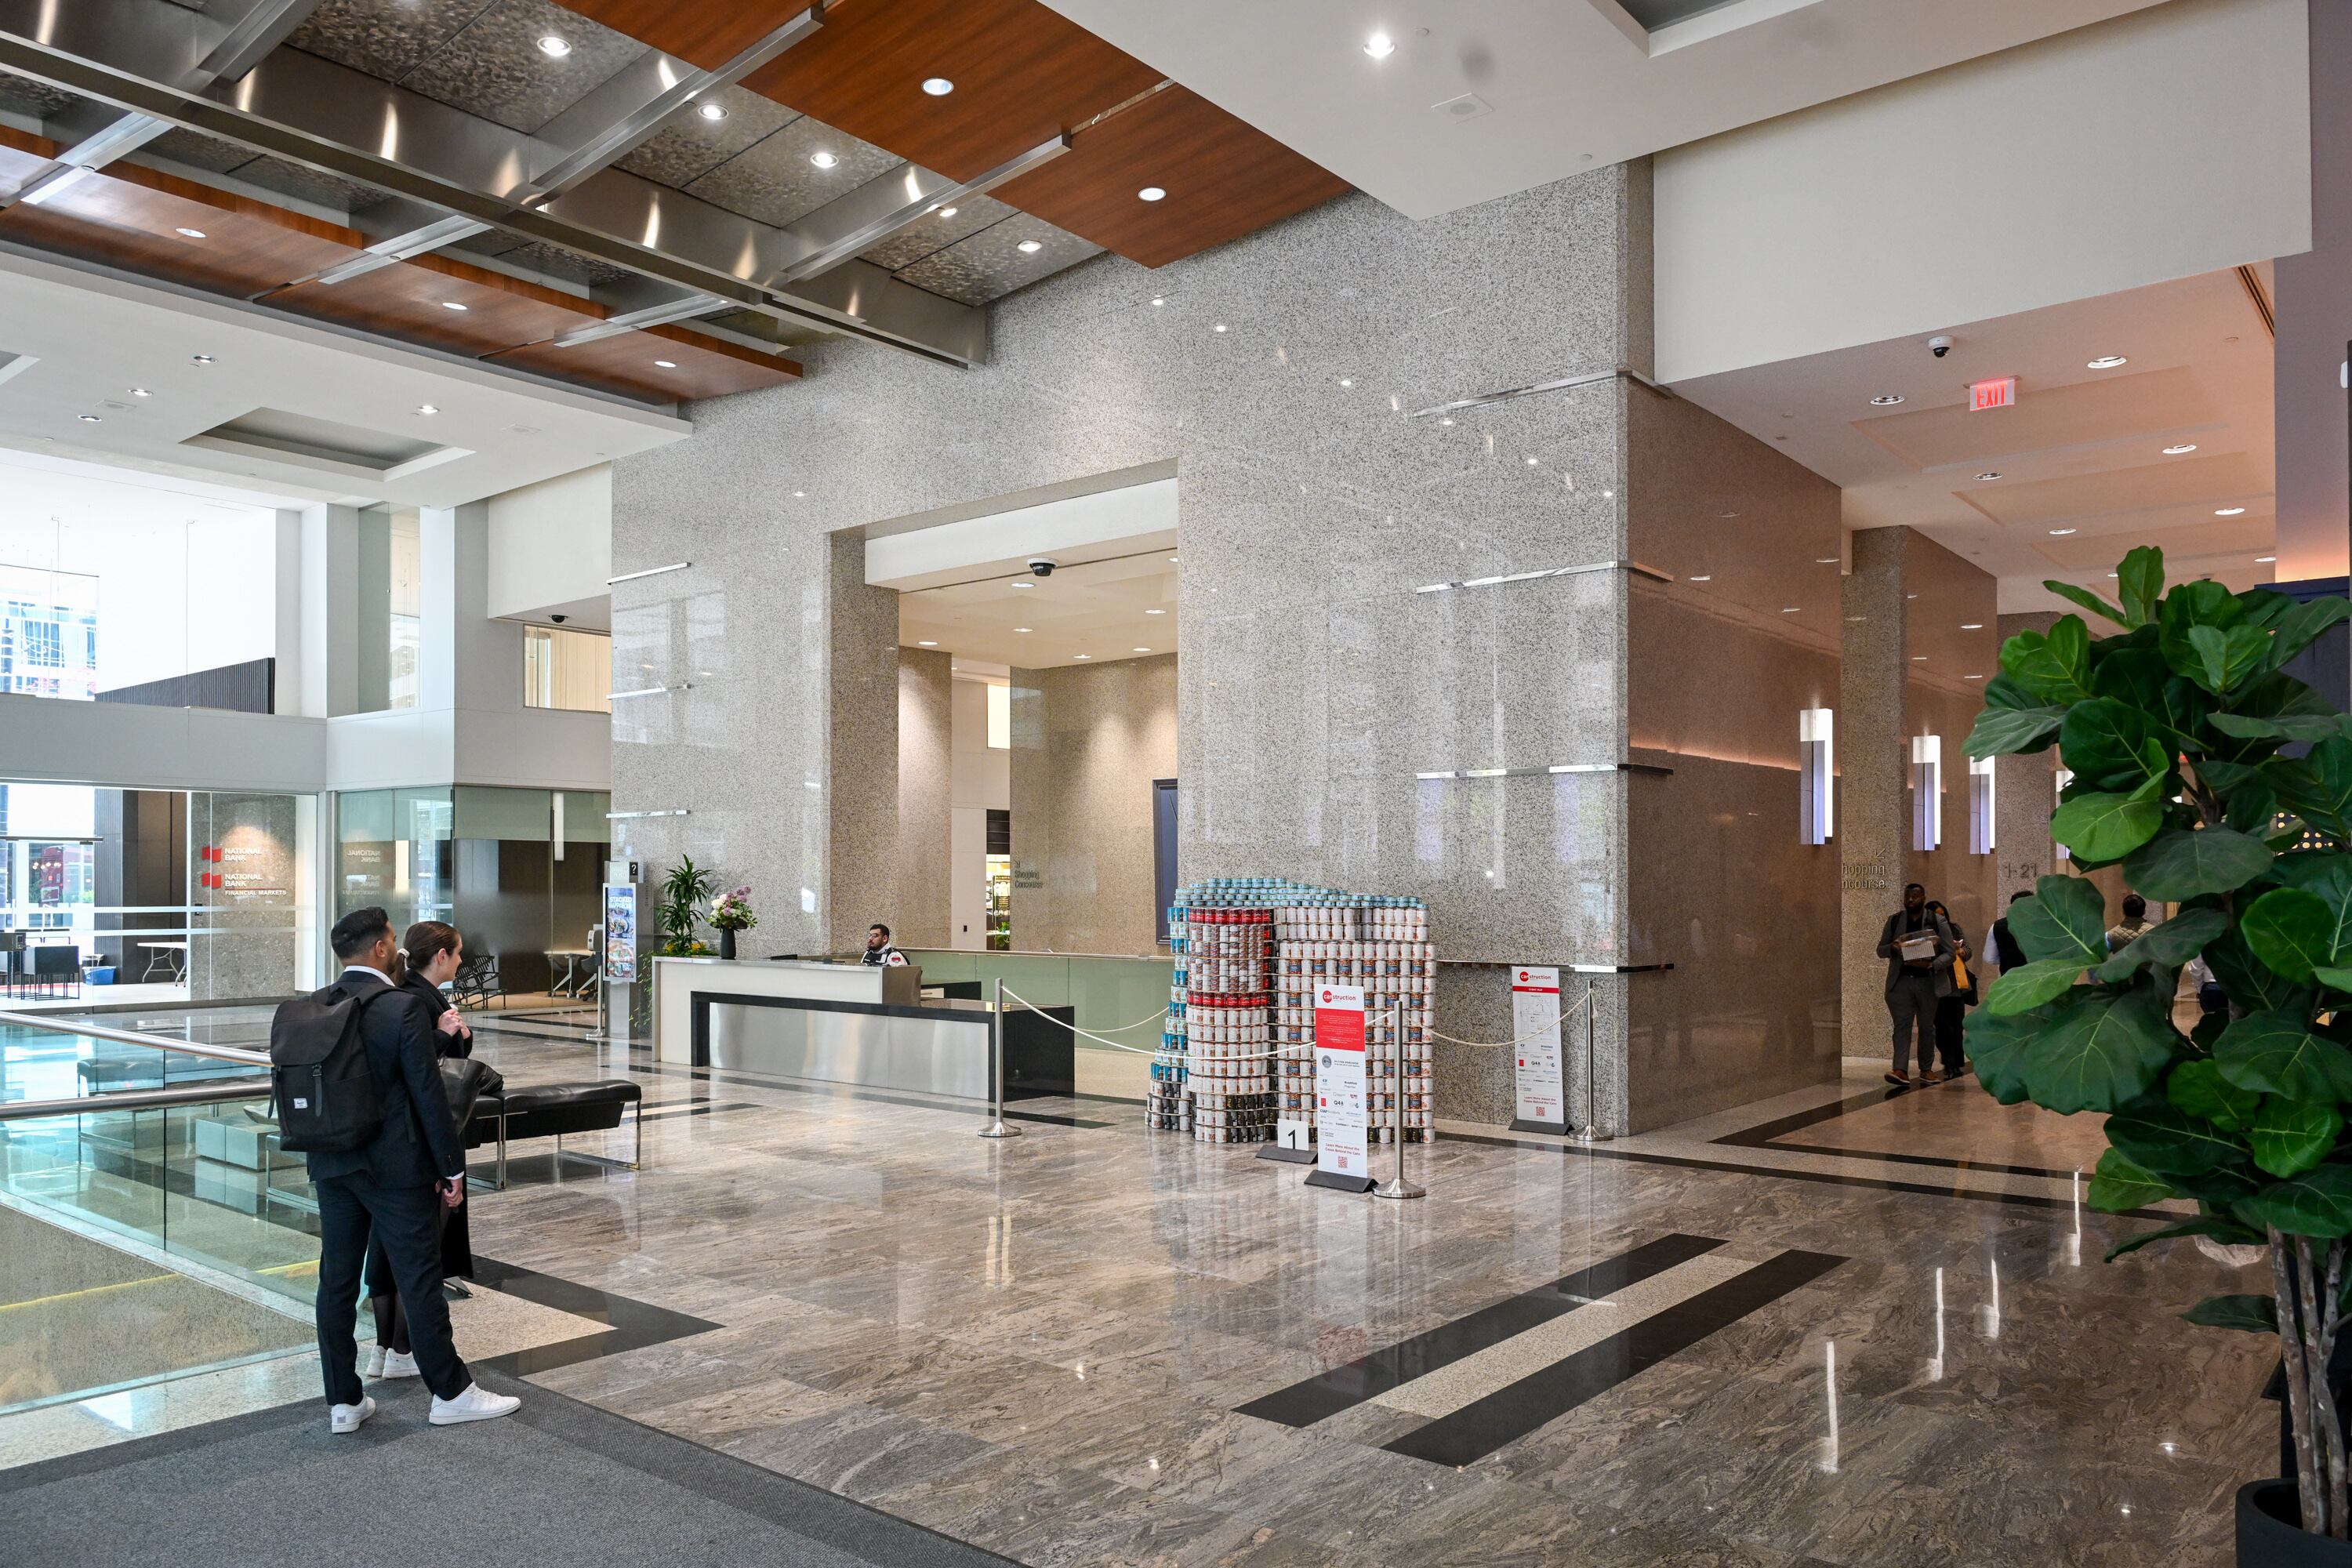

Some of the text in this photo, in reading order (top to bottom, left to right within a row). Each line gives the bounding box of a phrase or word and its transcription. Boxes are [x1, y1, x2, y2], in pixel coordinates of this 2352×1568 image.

[1976, 383, 2008, 408] EXIT
[1014, 869, 1040, 880] Shopping
[1842, 862, 1886, 877] hopping
[1842, 880, 1887, 889] ncourse
[1288, 1129, 1296, 1149] 1
